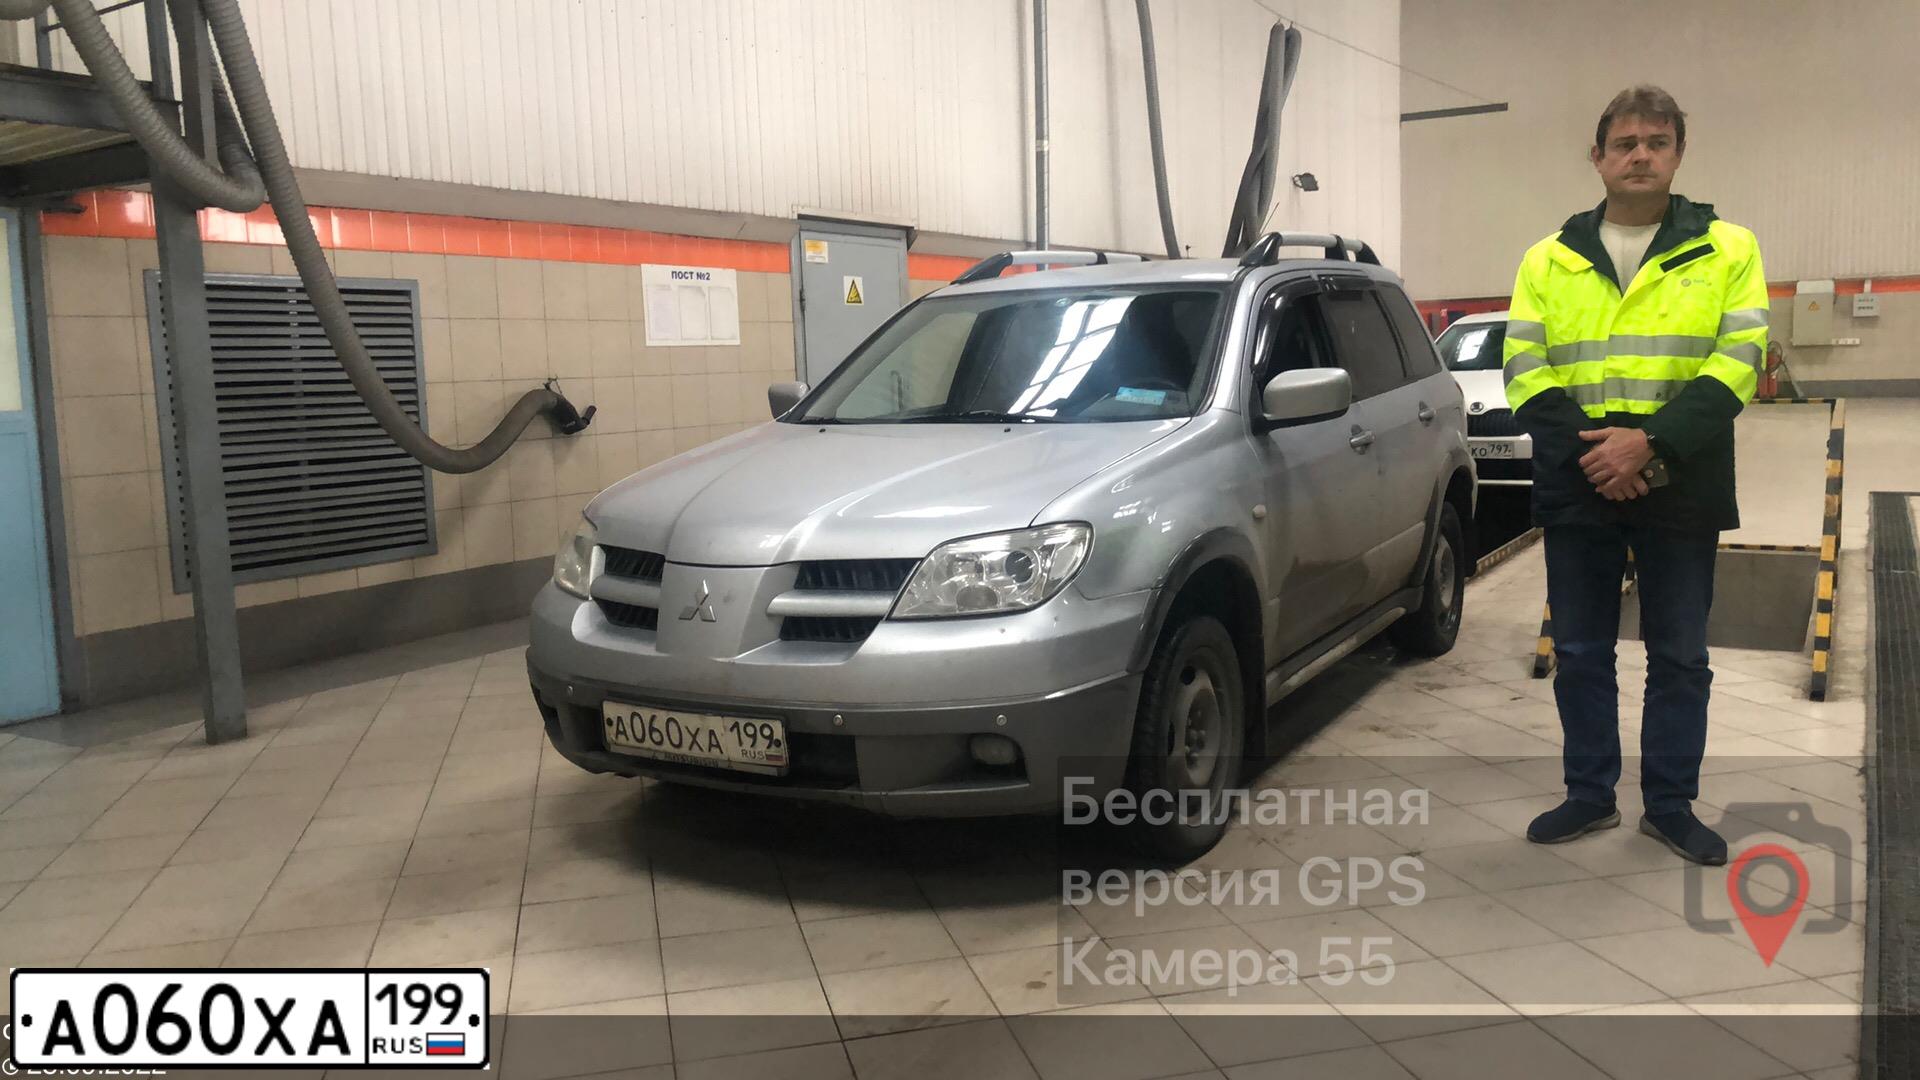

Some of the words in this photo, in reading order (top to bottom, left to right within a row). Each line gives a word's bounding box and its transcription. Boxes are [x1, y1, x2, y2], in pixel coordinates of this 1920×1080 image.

[671, 270, 694, 280] ПОСТ
[696, 271, 711, 281] №2
[1469, 446, 1487, 457] КО
[1489, 444, 1509, 454] 797
[614, 711, 724, 754] А060ХА
[729, 720, 774, 749] 199
[741, 748, 765, 760] RUS
